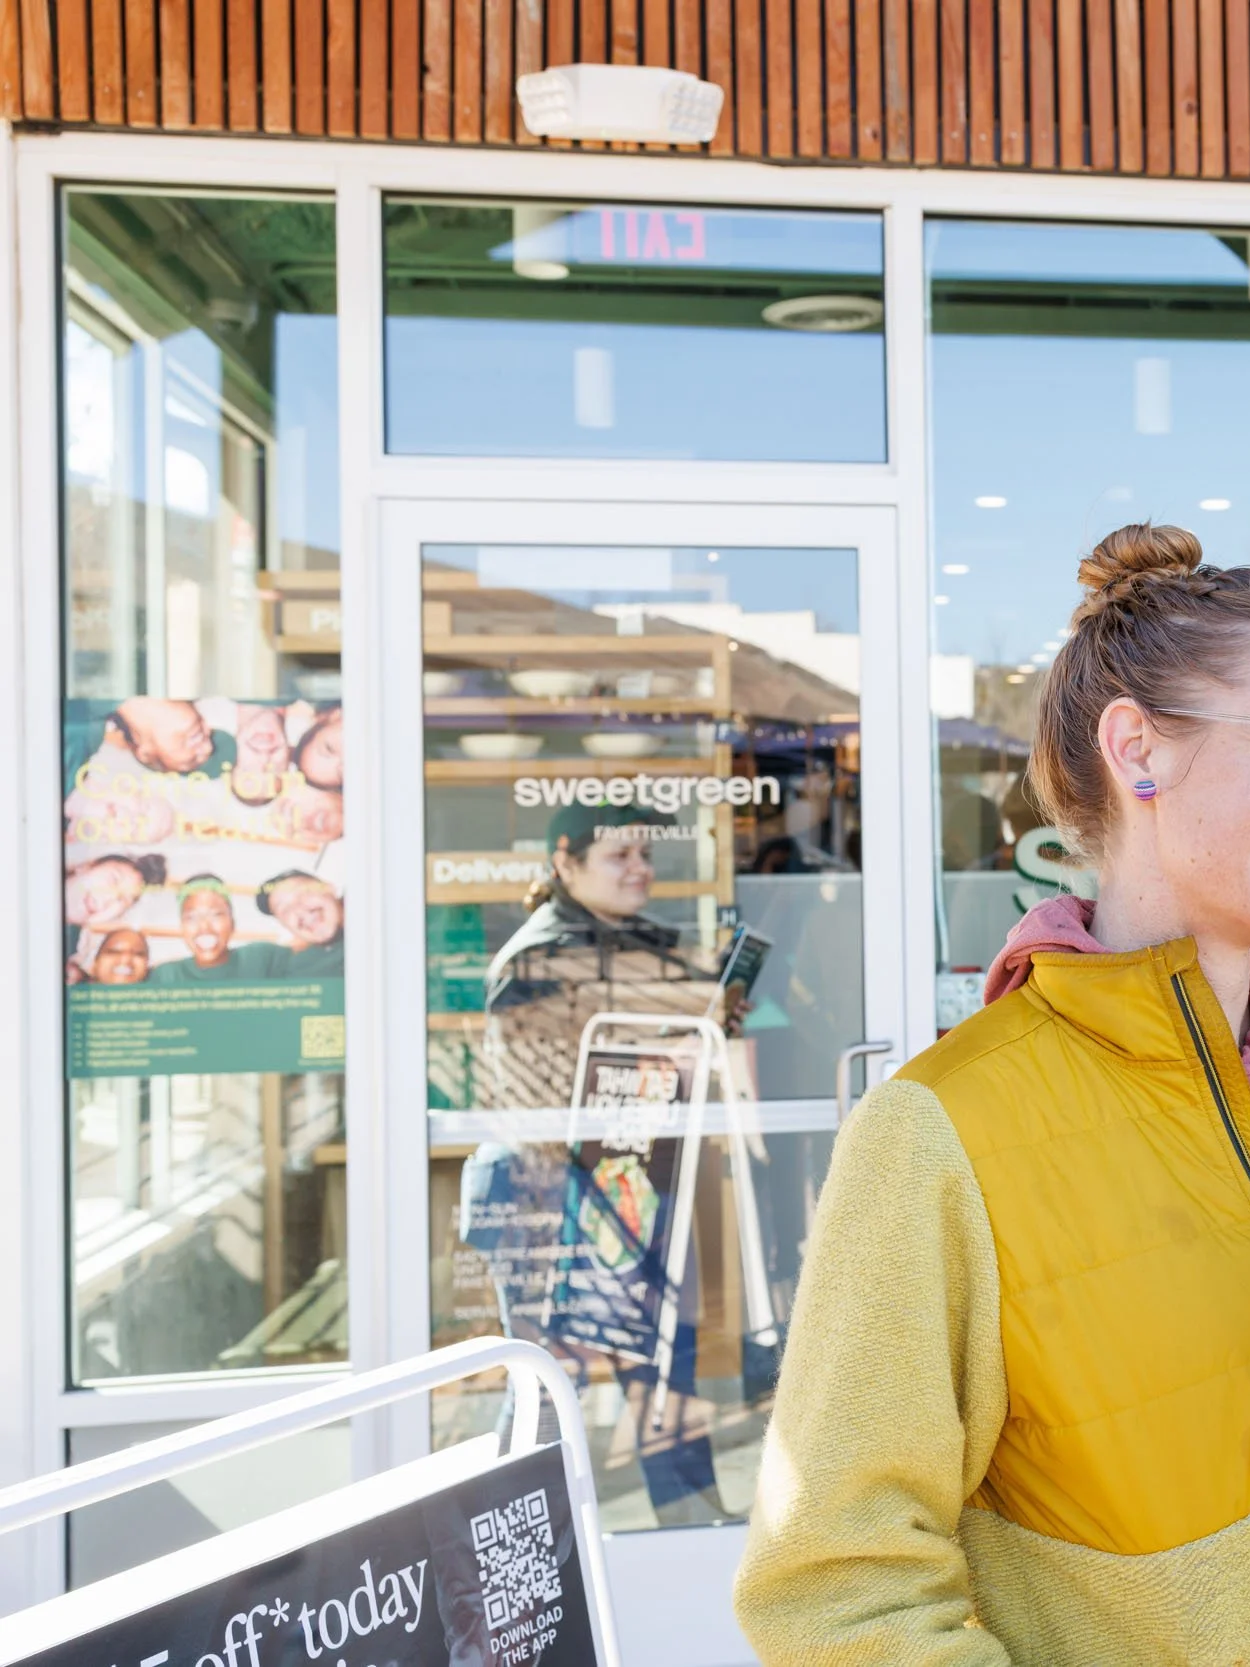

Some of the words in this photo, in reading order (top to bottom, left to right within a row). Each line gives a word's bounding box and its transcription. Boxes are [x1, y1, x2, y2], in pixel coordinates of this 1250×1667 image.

[75, 761, 210, 800] Come
[220, 760, 306, 804] join
[513, 772, 781, 815] sweetgreen
[593, 824, 701, 842] FAYETTEVILLE
[297, 1558, 428, 1660] today
[489, 1605, 564, 1654] DOWNLOAD
[501, 1644, 532, 1667] THE
[532, 1628, 558, 1660] APP
